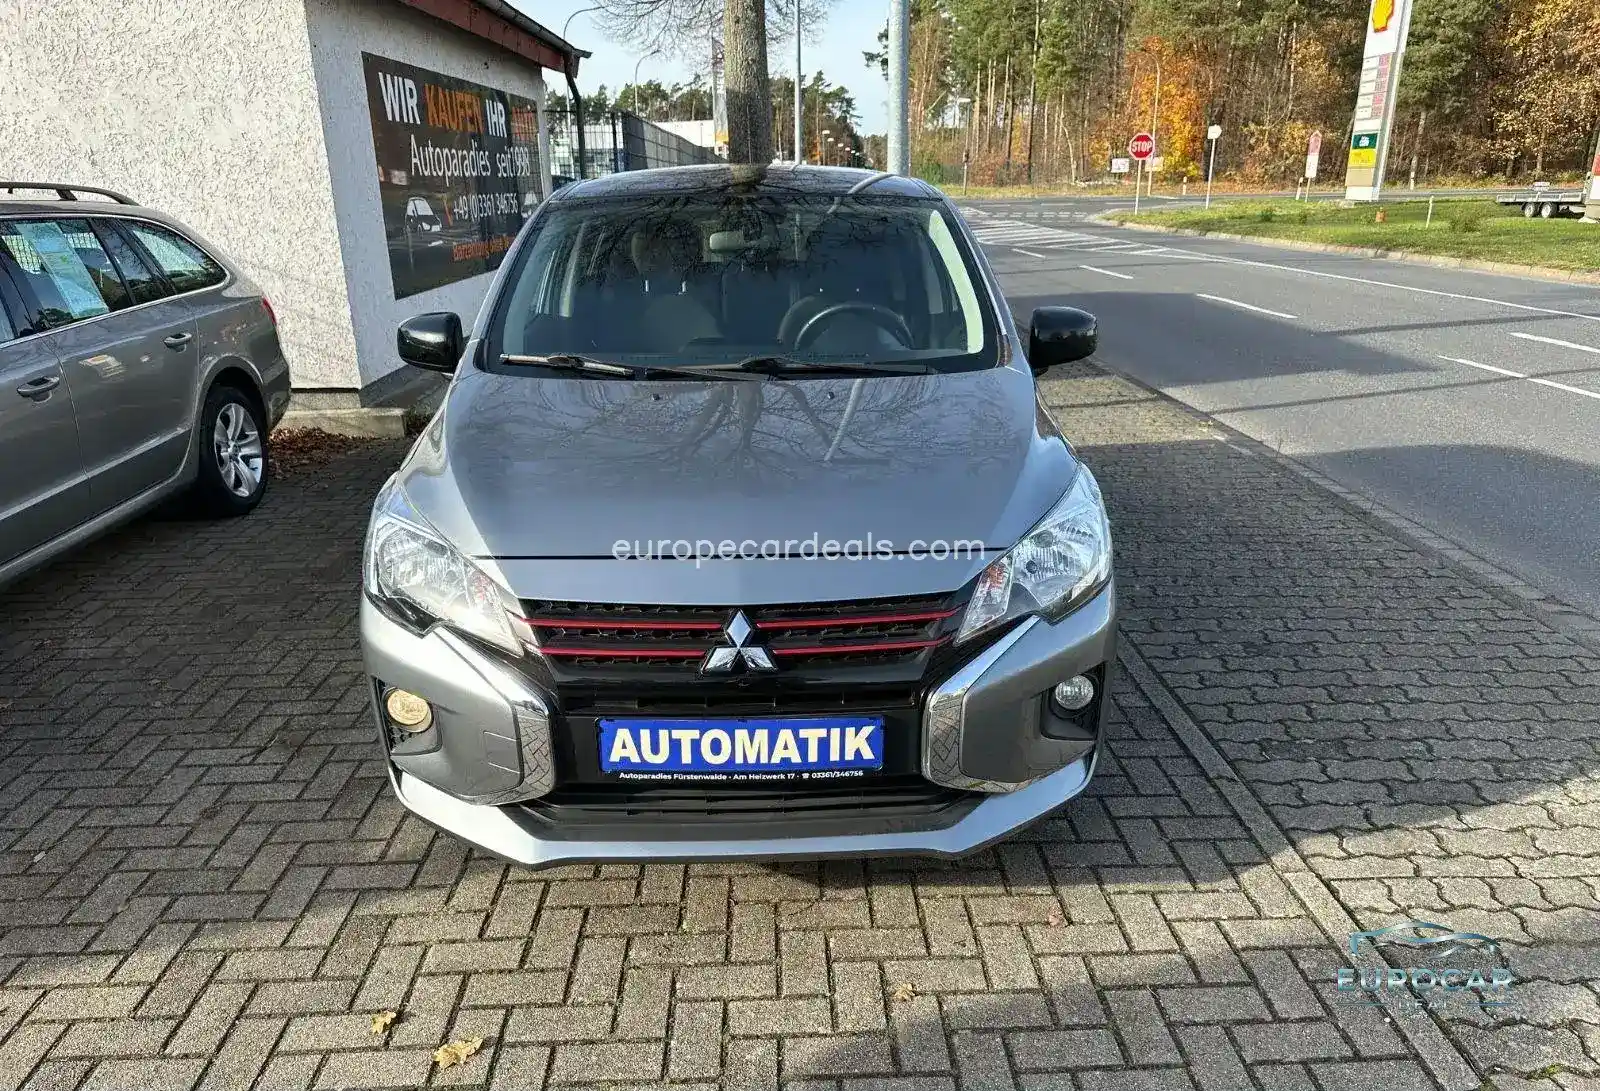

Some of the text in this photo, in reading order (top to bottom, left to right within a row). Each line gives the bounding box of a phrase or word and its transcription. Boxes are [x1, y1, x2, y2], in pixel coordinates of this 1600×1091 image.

[378, 72, 421, 124] WIR
[425, 83, 484, 133] KAUFEN
[486, 99, 507, 138] IHR
[411, 135, 490, 186] Autoparadies
[1132, 141, 1152, 153] STOP
[453, 195, 468, 220] +49
[609, 725, 876, 765] AUTOMATIK
[619, 772, 672, 780] Autoparadies
[673, 771, 727, 780] Fürstenwalde
[787, 772, 796, 780] 17
[811, 770, 864, 779] 03361/346756
